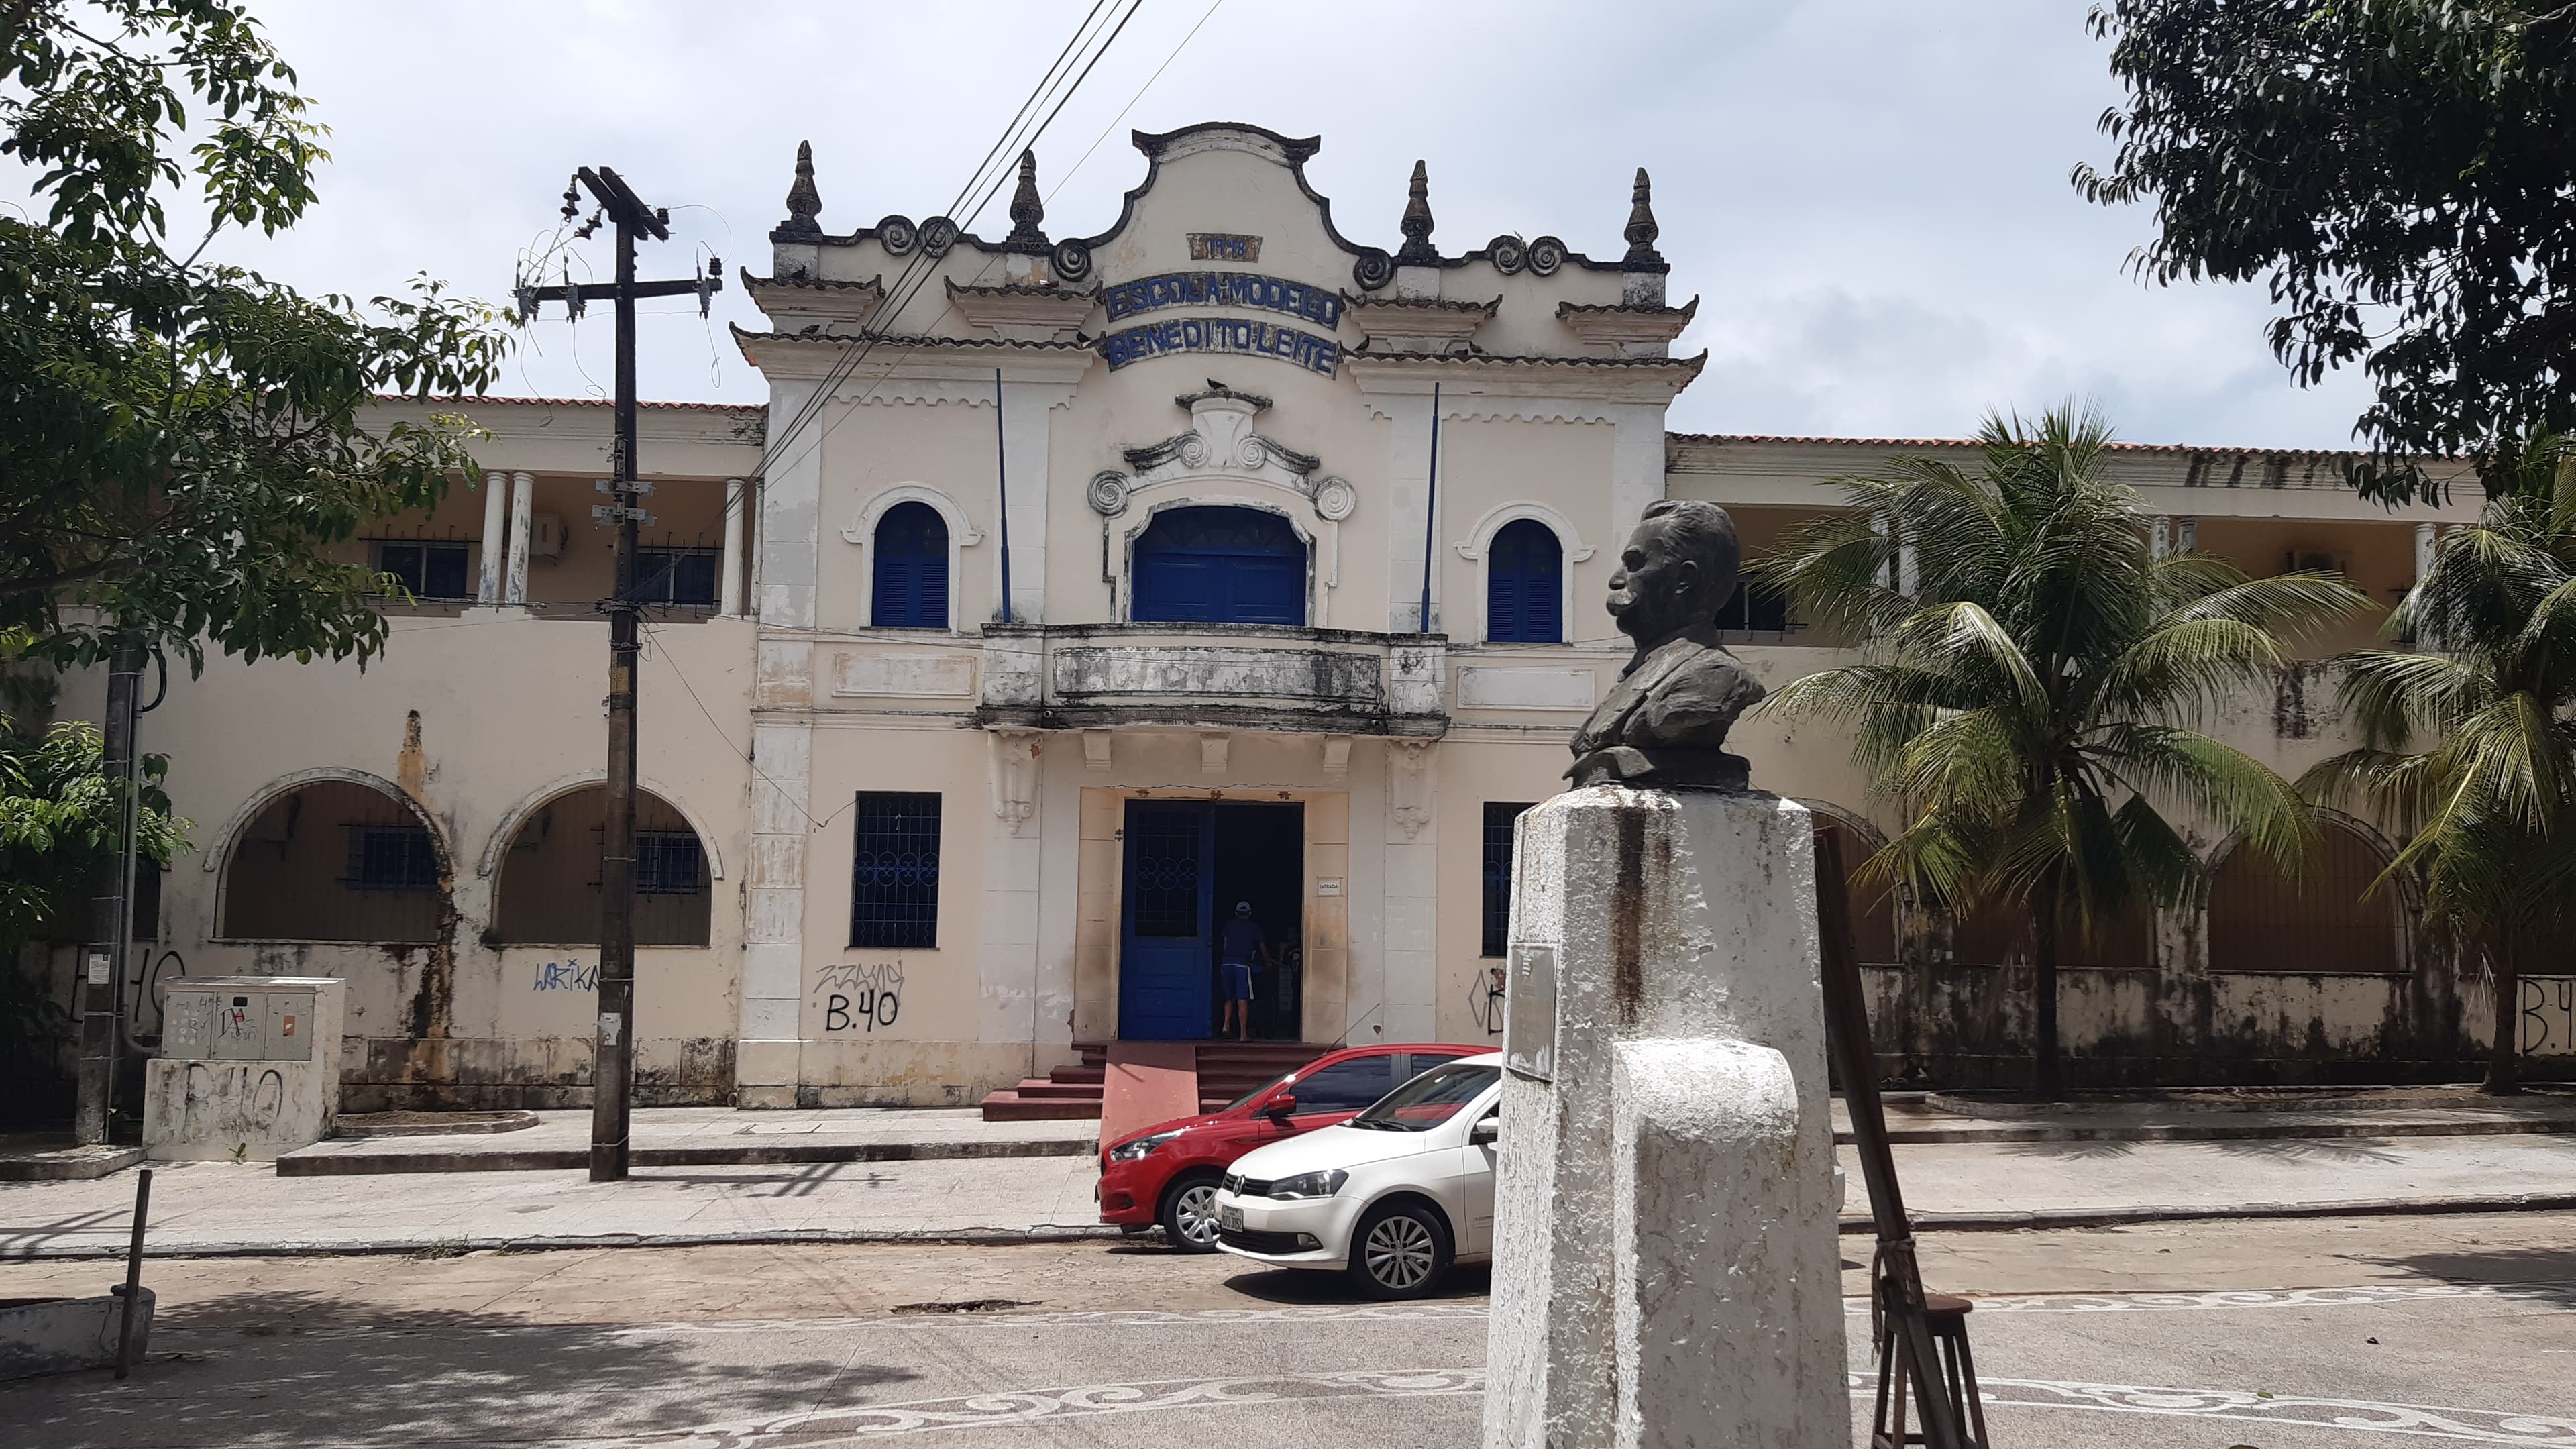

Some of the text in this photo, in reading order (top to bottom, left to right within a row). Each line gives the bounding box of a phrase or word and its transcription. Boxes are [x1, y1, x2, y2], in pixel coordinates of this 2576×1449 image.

[1206, 237, 1246, 258] 1948
[1110, 275, 1338, 324] ESCOLA MODELO
[1109, 321, 1337, 374] BENEDITO LEITE
[826, 989, 898, 1033] B.40
